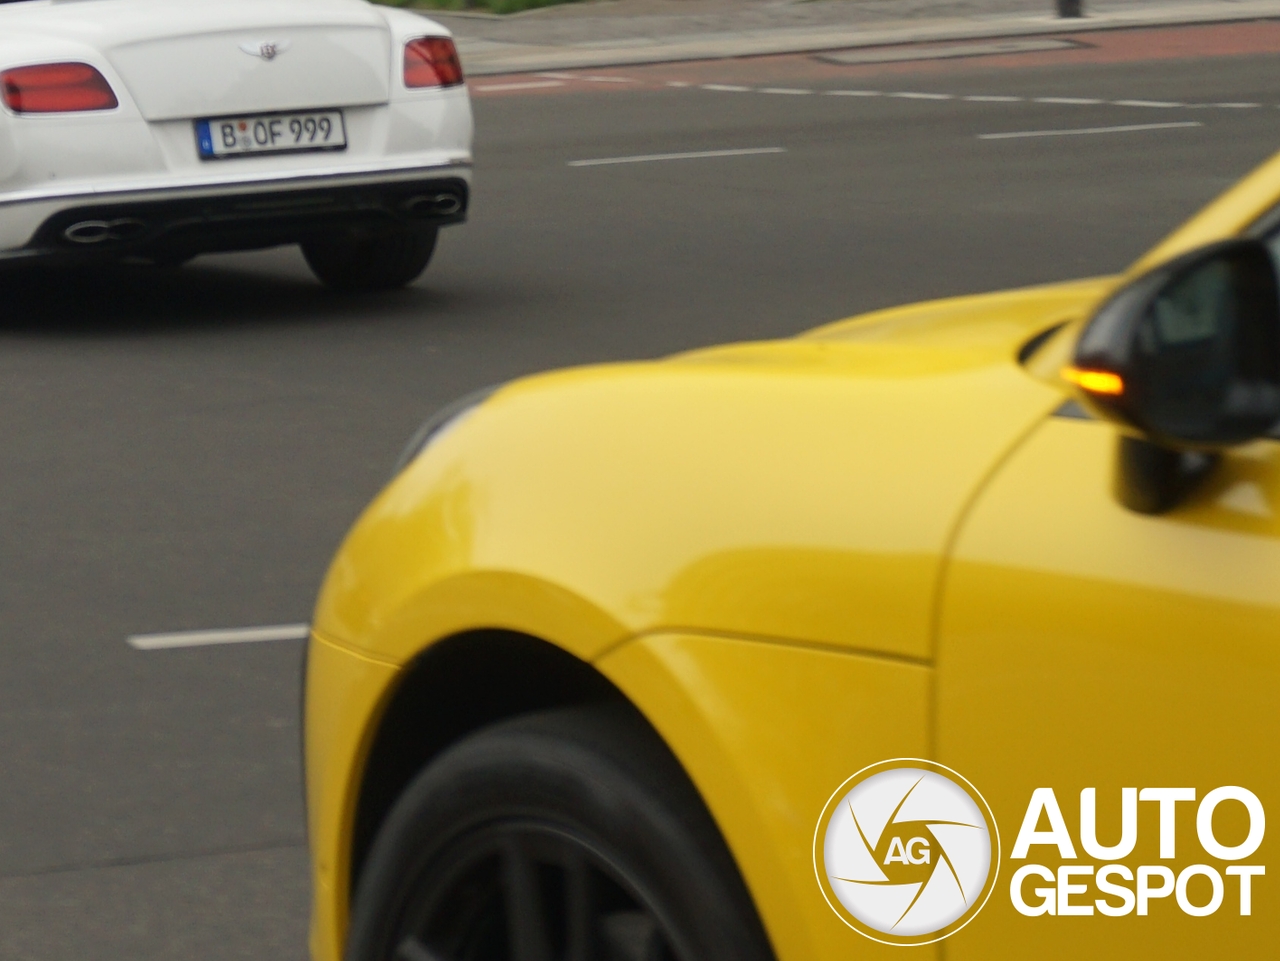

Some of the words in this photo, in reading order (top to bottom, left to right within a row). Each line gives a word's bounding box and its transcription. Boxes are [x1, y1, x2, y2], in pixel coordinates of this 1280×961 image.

[222, 124, 236, 147] B
[253, 120, 281, 145] OF
[289, 117, 331, 143] 999
